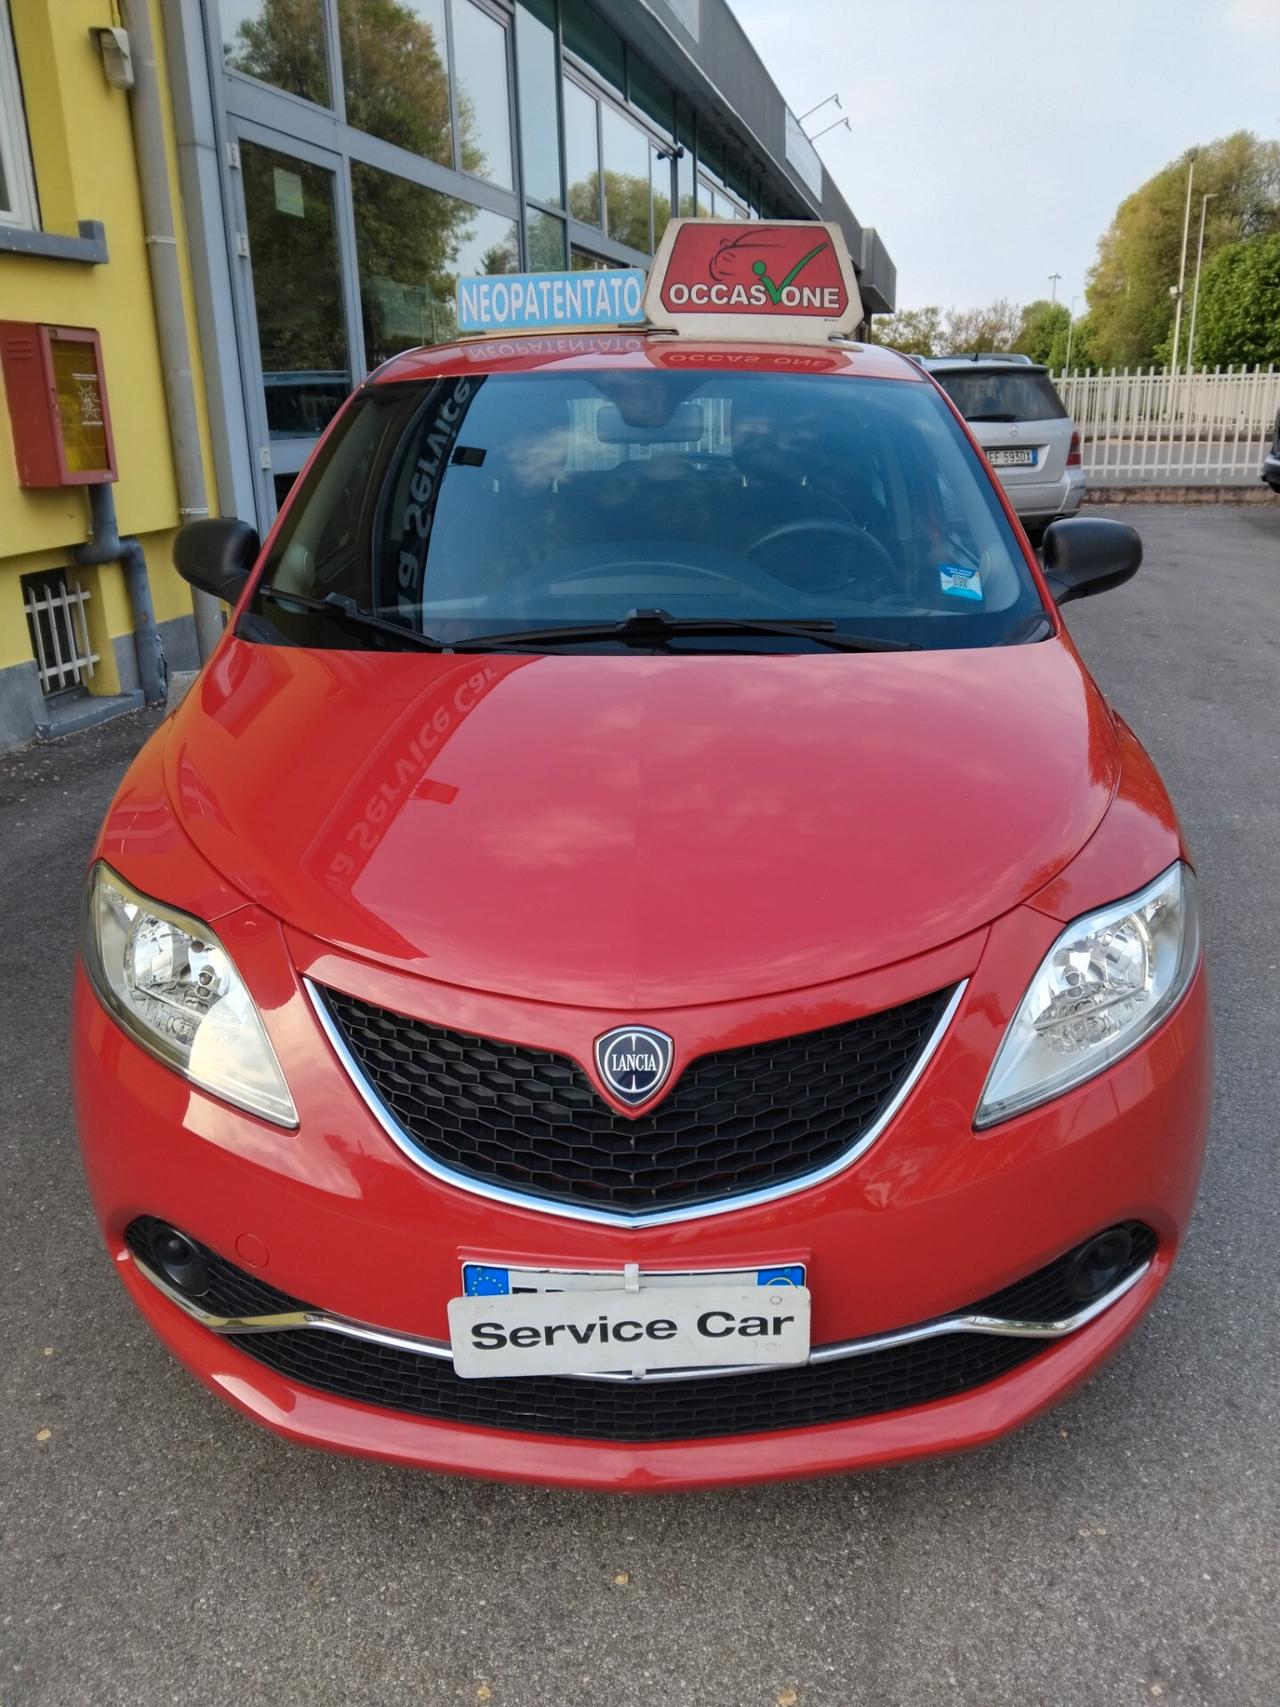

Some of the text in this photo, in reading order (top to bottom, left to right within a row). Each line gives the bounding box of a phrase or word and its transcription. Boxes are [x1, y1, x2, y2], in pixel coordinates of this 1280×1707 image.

[461, 275, 642, 324] NEOPATENTATO
[612, 1053, 658, 1072] LANCIA
[471, 1311, 795, 1350] Service Car
